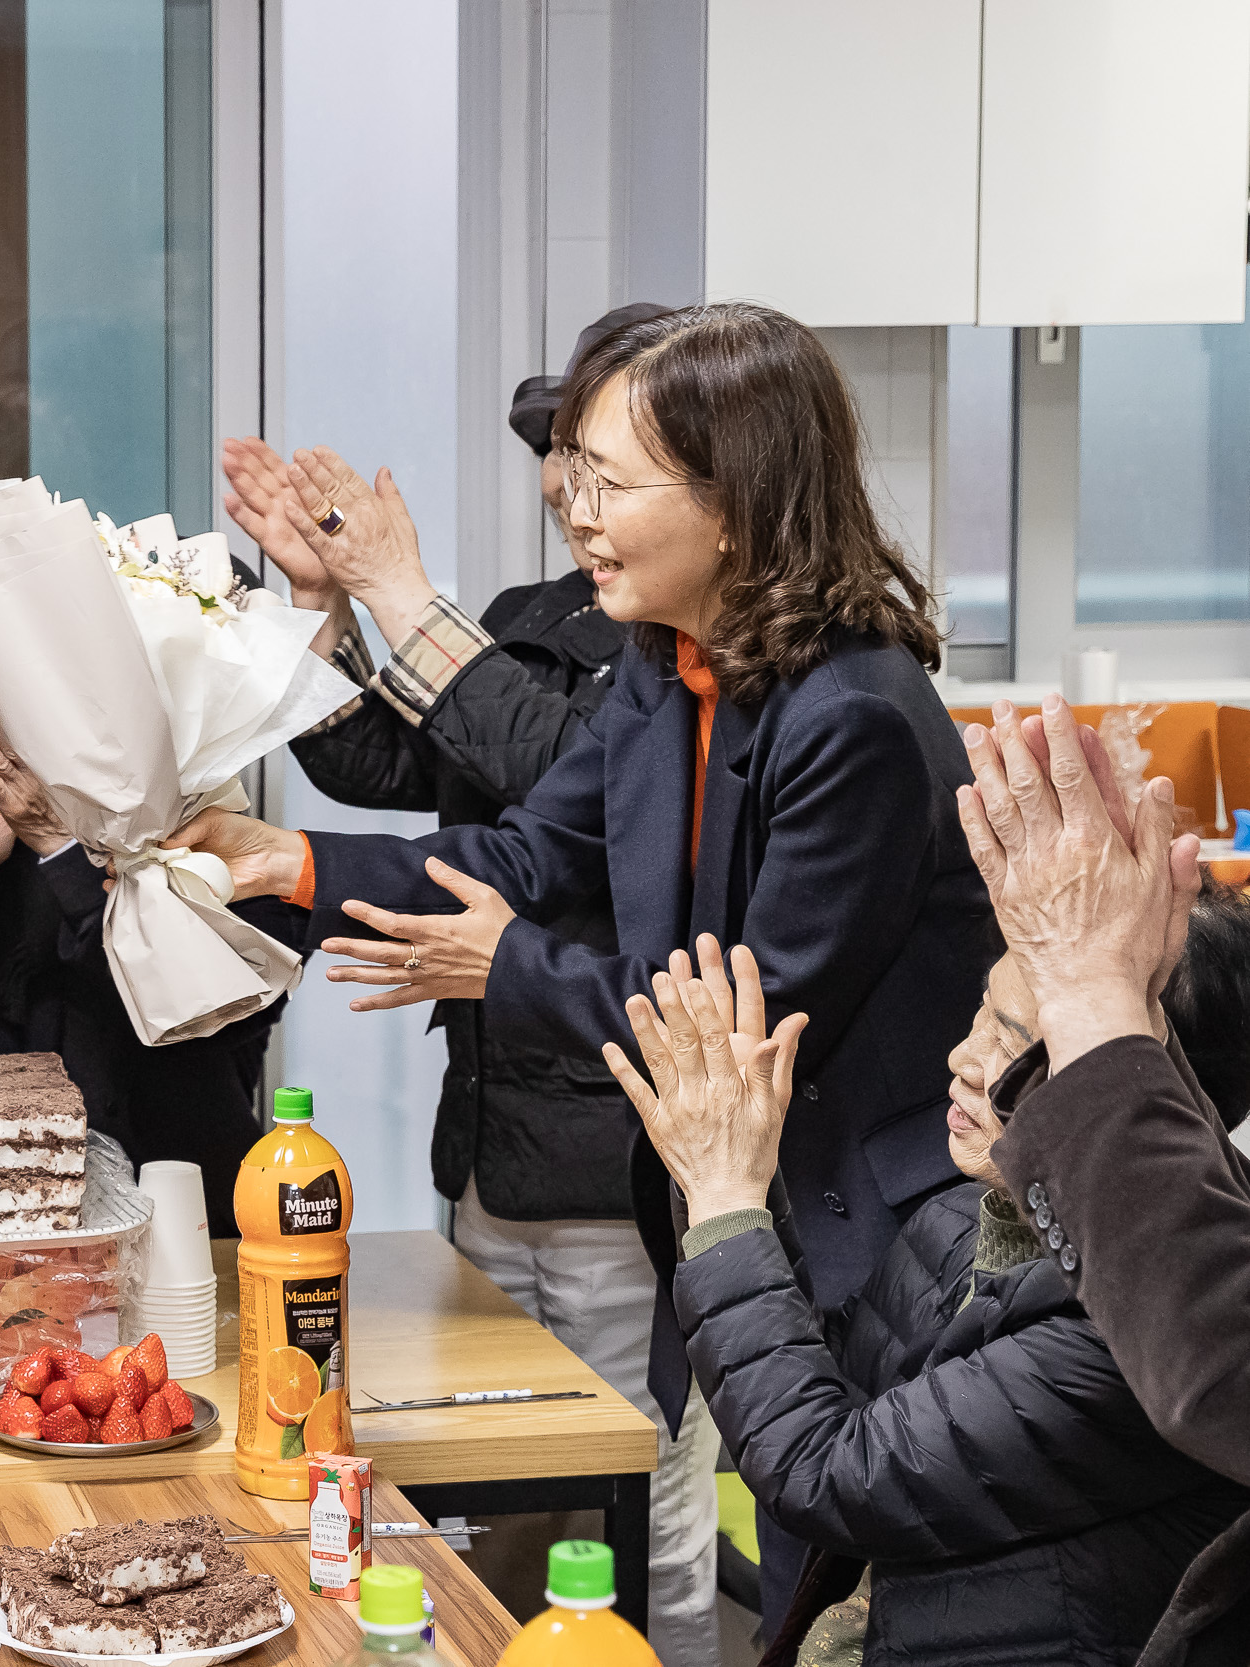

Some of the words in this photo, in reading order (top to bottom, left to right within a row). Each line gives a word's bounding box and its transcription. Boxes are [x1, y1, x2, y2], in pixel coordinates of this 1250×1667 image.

[285, 1197, 338, 1213] Minute
[293, 1212, 332, 1227] Maid
[298, 1318, 315, 1328] 아연
[317, 1316, 334, 1328] 풍부
[325, 1512, 348, 1522] 상하목장
[315, 1533, 331, 1541] 유기농
